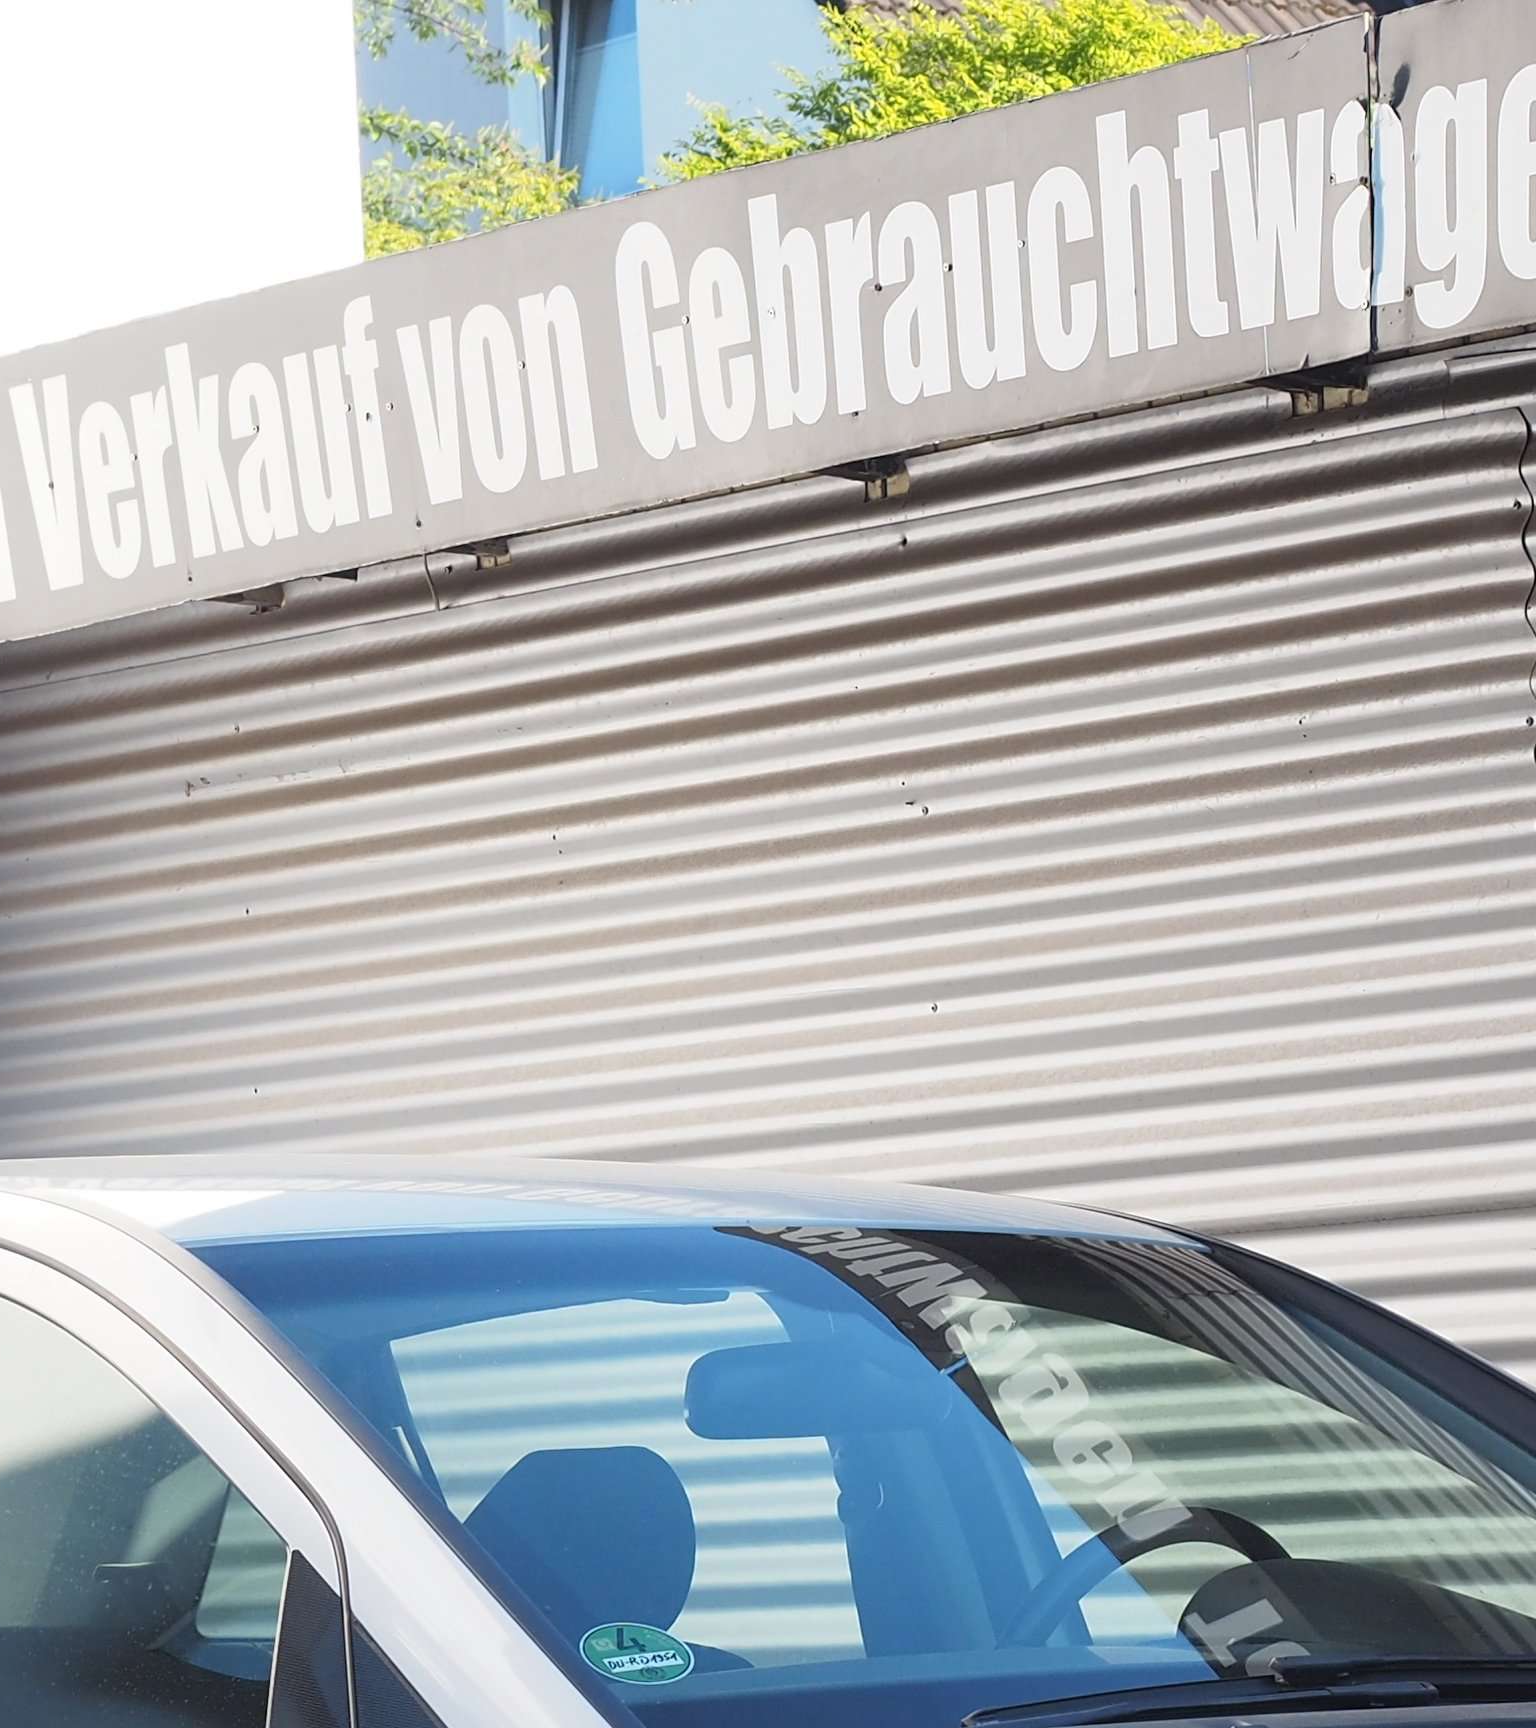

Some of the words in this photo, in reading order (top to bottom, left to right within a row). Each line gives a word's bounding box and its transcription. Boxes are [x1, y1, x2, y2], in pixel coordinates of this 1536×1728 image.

[9, 296, 394, 592] Verkauf
[395, 283, 598, 507] von
[616, 1627, 647, 1652] 4
